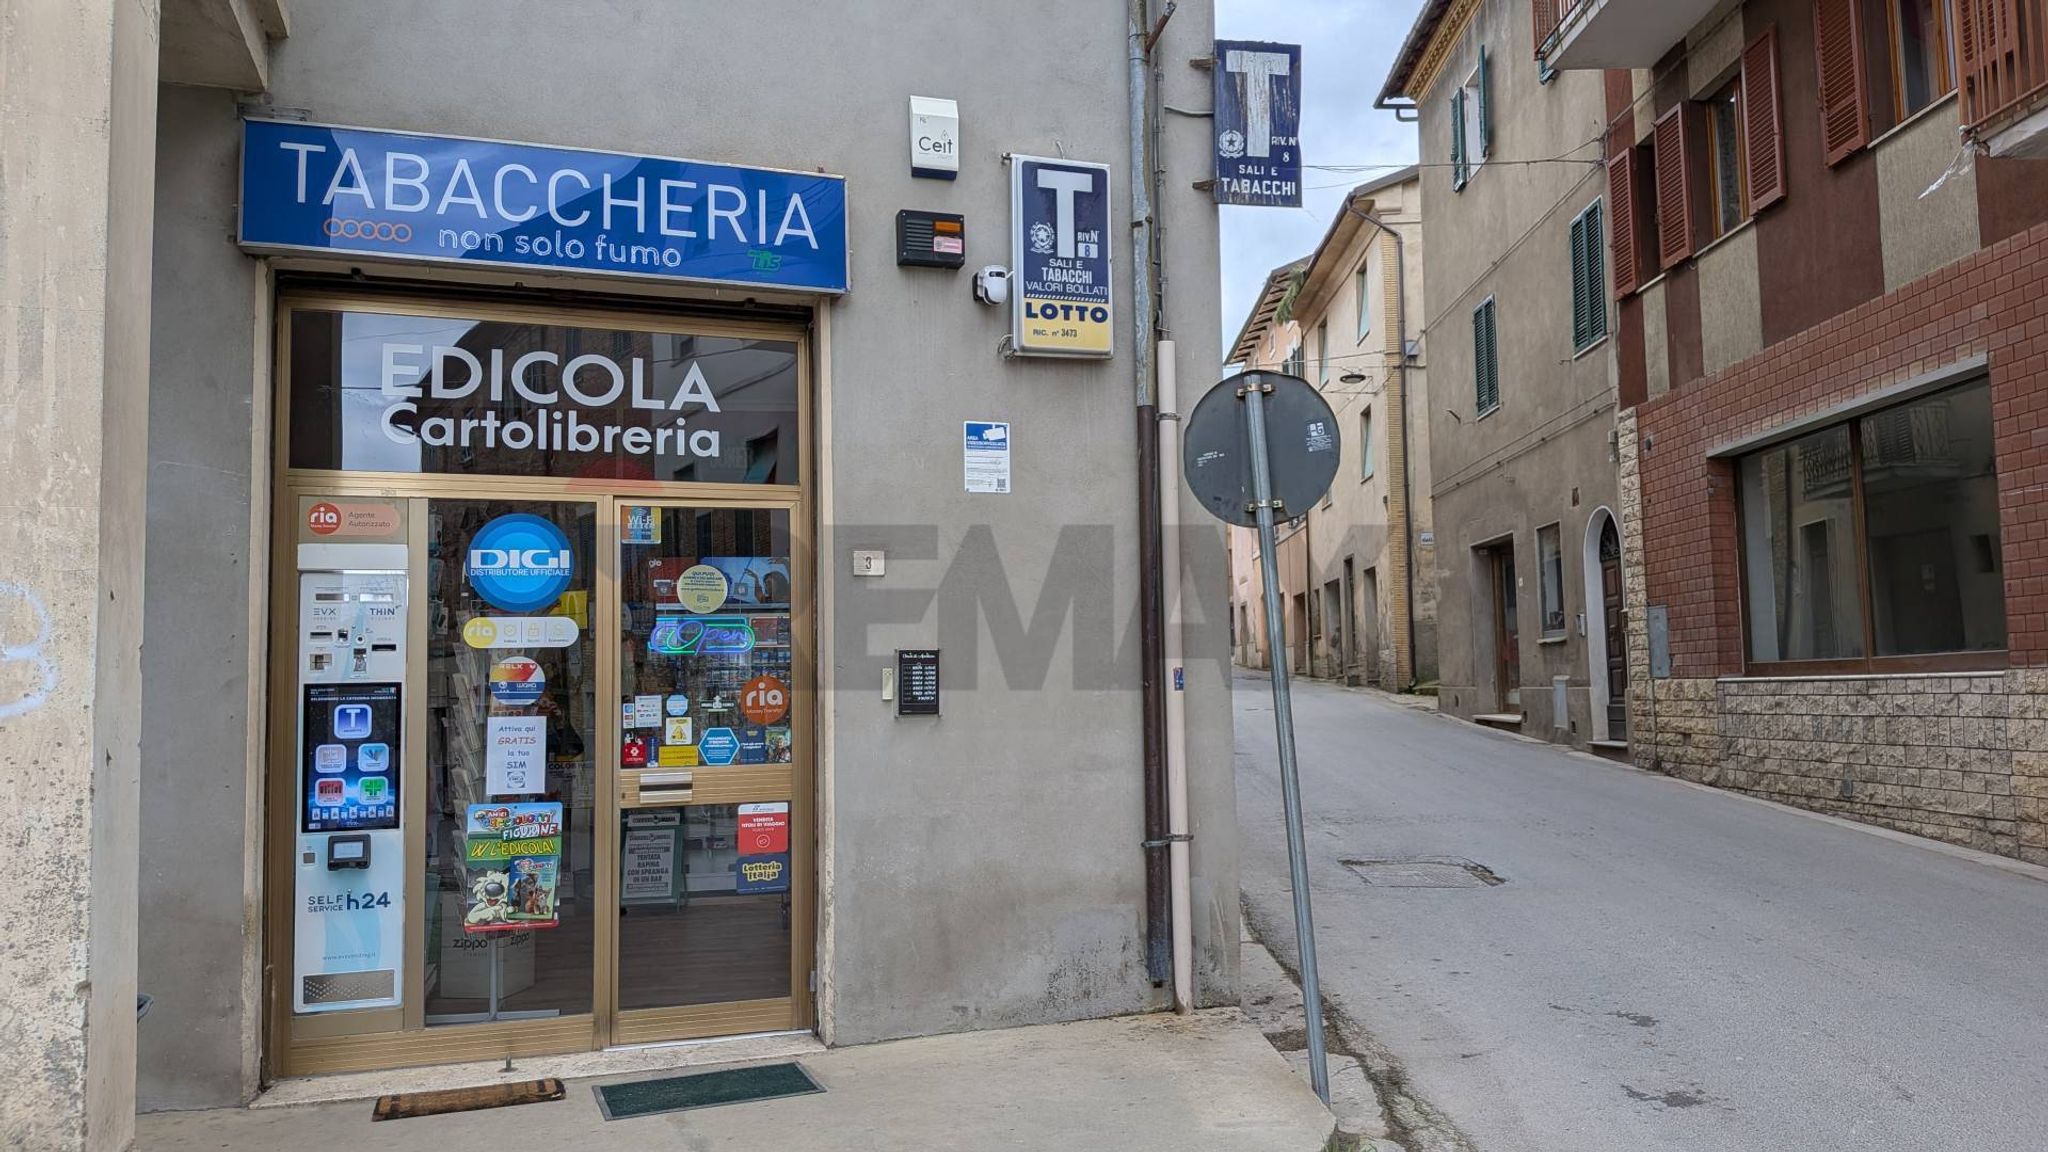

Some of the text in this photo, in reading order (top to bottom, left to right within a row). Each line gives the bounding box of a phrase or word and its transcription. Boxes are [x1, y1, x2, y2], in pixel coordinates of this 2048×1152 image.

[1226, 50, 1290, 158] T
[918, 135, 954, 155] Ceit
[1282, 151, 1290, 163] 8
[1239, 164, 1279, 176] SALI E
[1221, 177, 1297, 196] TABACCHI
[280, 141, 820, 250] TABACCHERIA
[1037, 168, 1093, 259] T
[438, 227, 504, 252] non
[514, 229, 585, 259] solo
[595, 233, 682, 268] fumo
[1084, 244, 1091, 257] 8
[1049, 258, 1084, 269] SALI E
[1041, 267, 1093, 284] TABACCHI
[1026, 281, 1108, 296] VALORI BOLLATI
[1025, 302, 1108, 323] LOTTO
[1061, 328, 1077, 337] 3473
[381, 344, 722, 414] EDICOLA
[381, 401, 721, 458] Cartolibreria
[310, 506, 337, 523] ria
[348, 520, 391, 528] Autorizzato
[470, 549, 570, 569] DIGI
[865, 556, 872, 570] 3
[470, 568, 570, 577] DISTRIBUTORE UFFICIALE
[369, 608, 395, 616] THIN
[746, 682, 783, 707] ria
[346, 709, 360, 728] T
[524, 726, 536, 734] qui
[507, 761, 527, 769] SIM
[503, 823, 558, 840] FIGURINE
[743, 862, 782, 873] Lotteria
[748, 869, 778, 880] Italia
[308, 892, 391, 910] SELF h24
[308, 905, 344, 913] SERVICE
[453, 938, 488, 950] zippo
